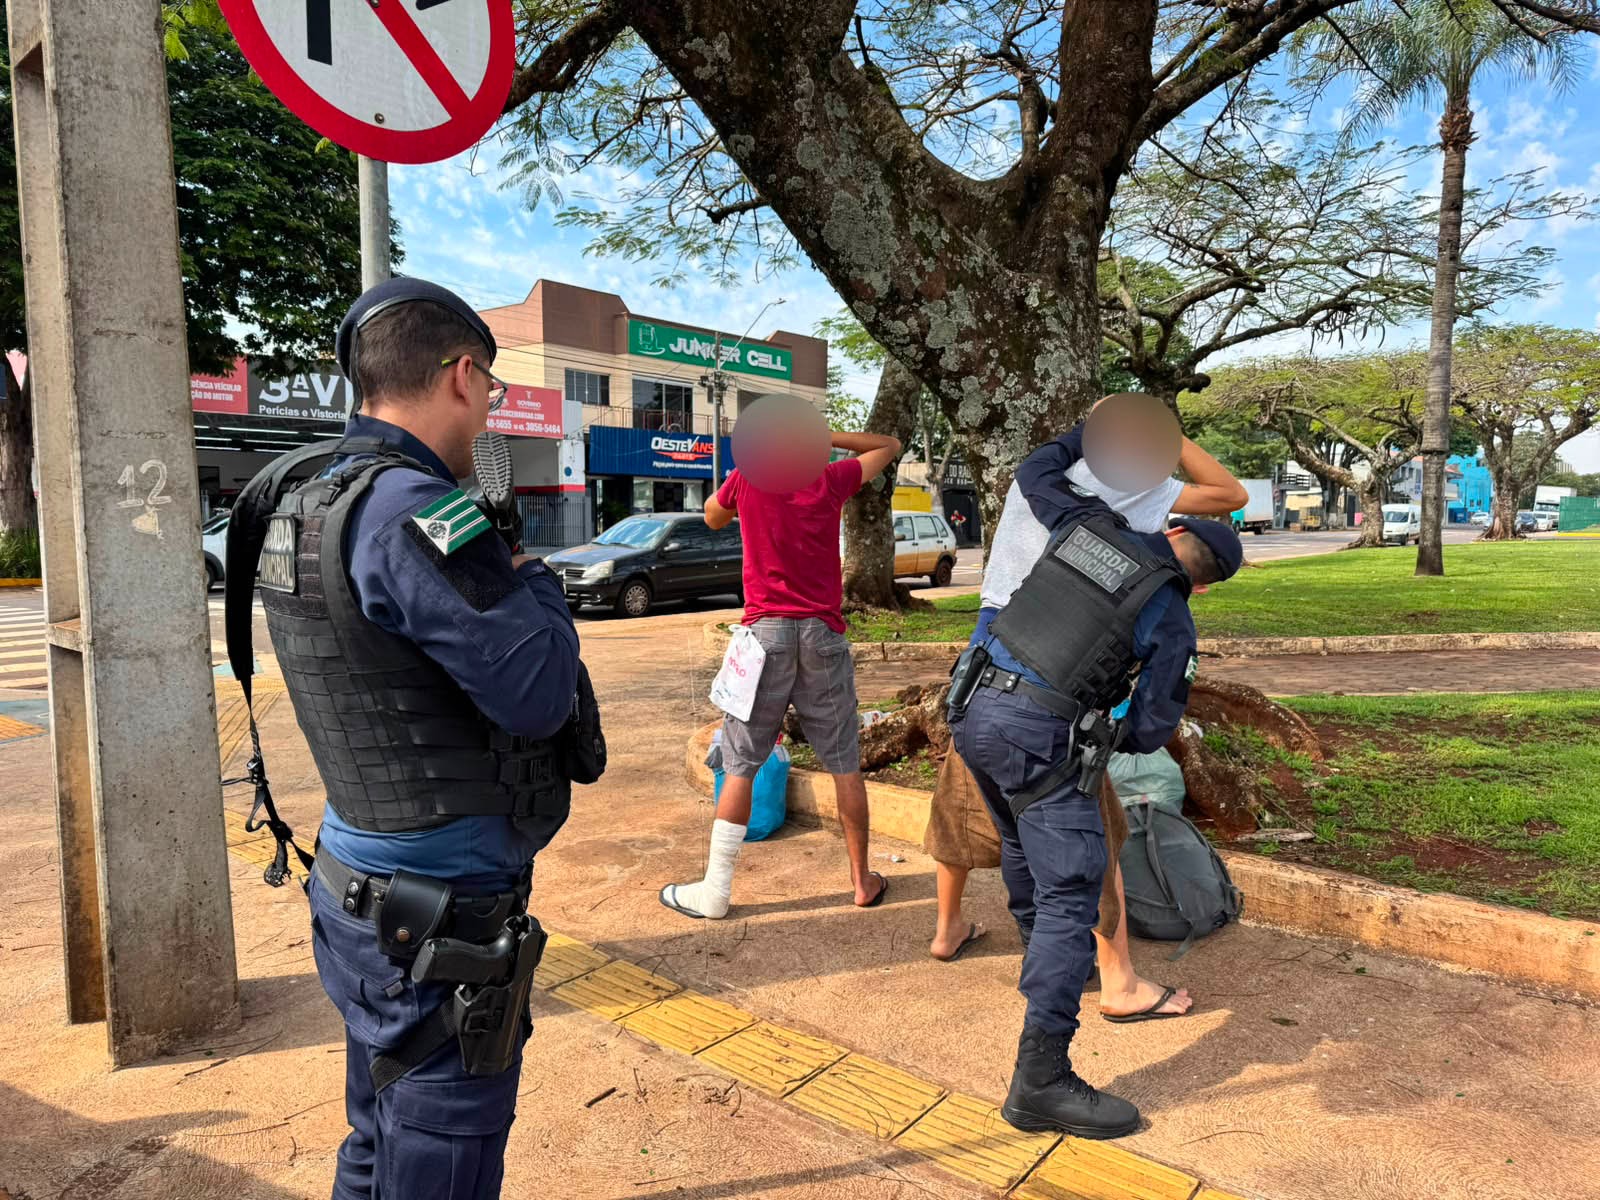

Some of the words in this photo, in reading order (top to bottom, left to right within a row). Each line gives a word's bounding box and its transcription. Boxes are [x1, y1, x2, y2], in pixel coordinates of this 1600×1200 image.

[670, 337, 740, 363] JUNKER
[747, 350, 787, 372] CELL
[259, 404, 299, 417] Perícias
[302, 408, 309, 417] e
[310, 407, 345, 420] Vistoria
[117, 460, 172, 508] 12
[1063, 543, 1117, 587] MUNICIPAL
[1073, 531, 1129, 575] GUARDA
